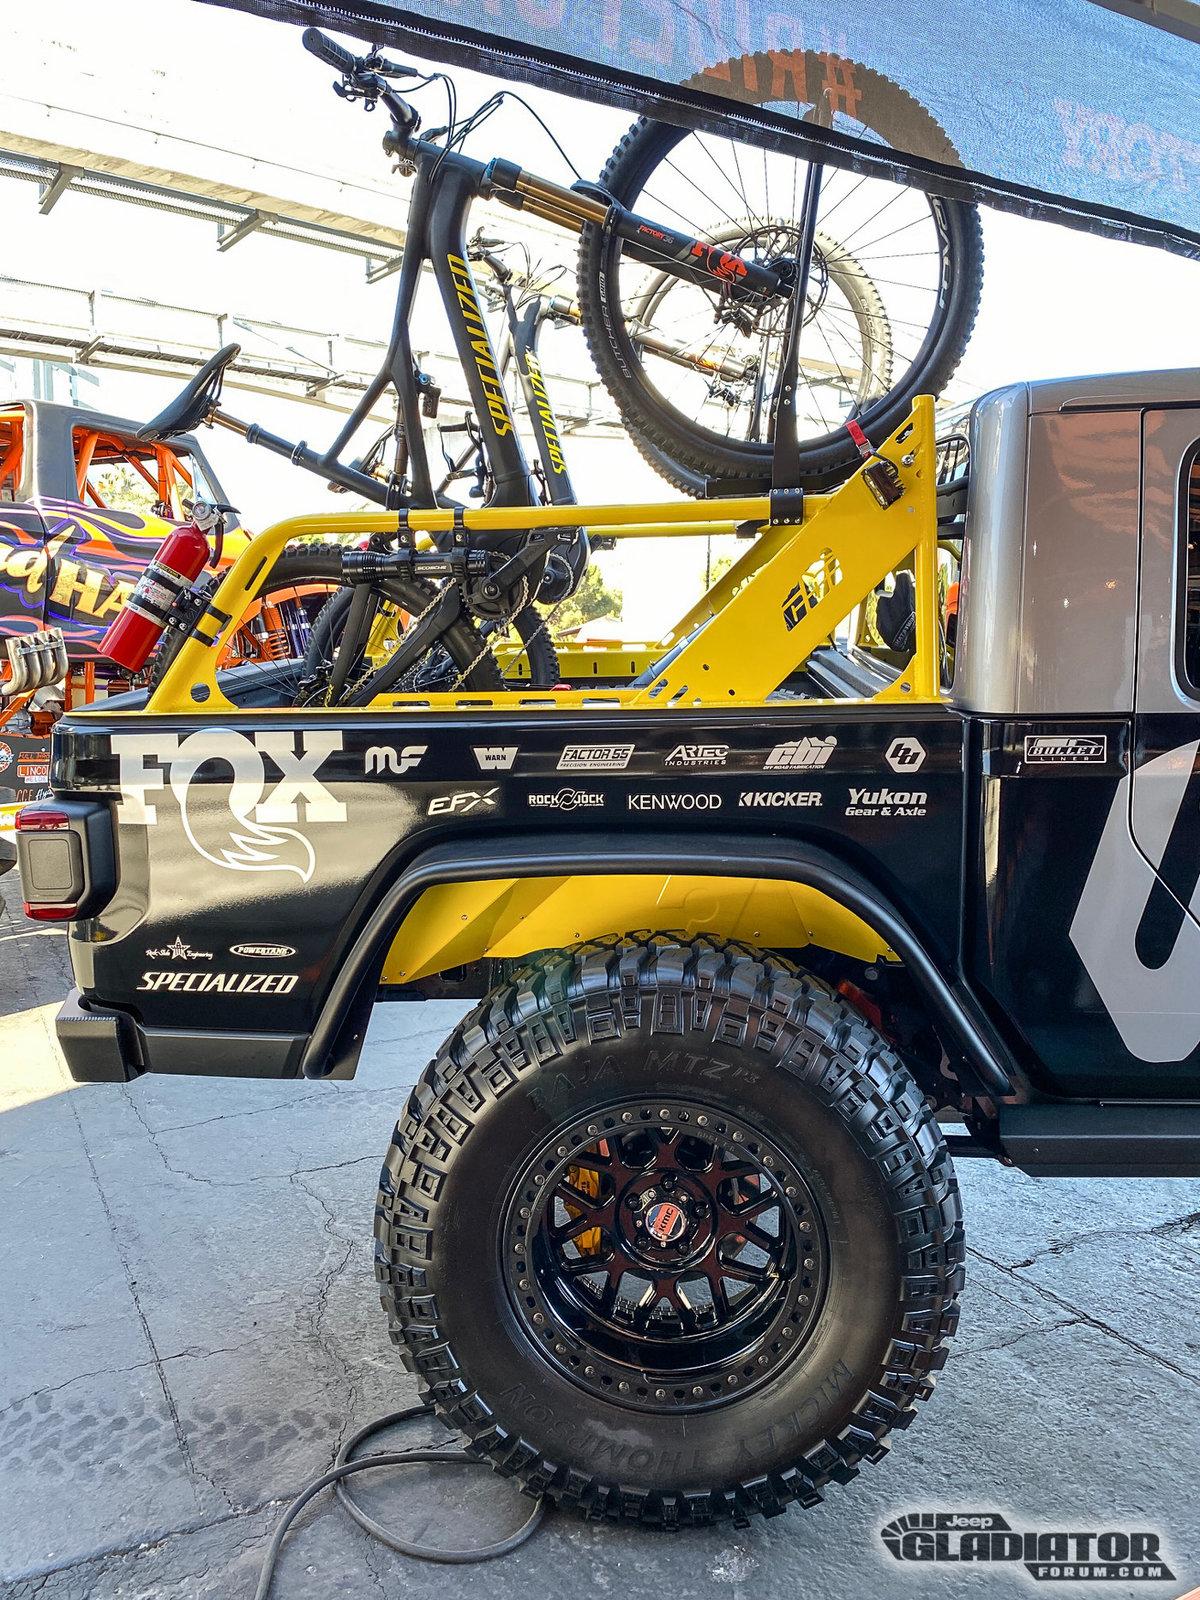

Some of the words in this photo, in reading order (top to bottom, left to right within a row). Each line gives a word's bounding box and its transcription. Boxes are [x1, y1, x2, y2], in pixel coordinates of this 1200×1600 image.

[638, 224, 665, 240] FACTORY
[663, 233, 674, 244] 36
[447, 253, 513, 437] SPECIALIZED
[562, 749, 611, 760] FACTOR
[665, 744, 729, 760] ARTEC
[1029, 746, 1102, 756] BULLET
[111, 728, 347, 883] FOX
[428, 788, 499, 815] EFX
[528, 794, 560, 805] ROCK
[574, 793, 605, 804] JOCK
[628, 794, 722, 810] KENWOOD
[849, 788, 928, 805] Yukon
[845, 806, 879, 816] Gear
[880, 807, 892, 816] &
[893, 806, 927, 816] Axle
[136, 972, 299, 994] SPECIALIZED
[526, 1055, 625, 1111] BAJA
[735, 1357, 859, 1469] MICKEY
[498, 1377, 704, 1474] THOMPSON
